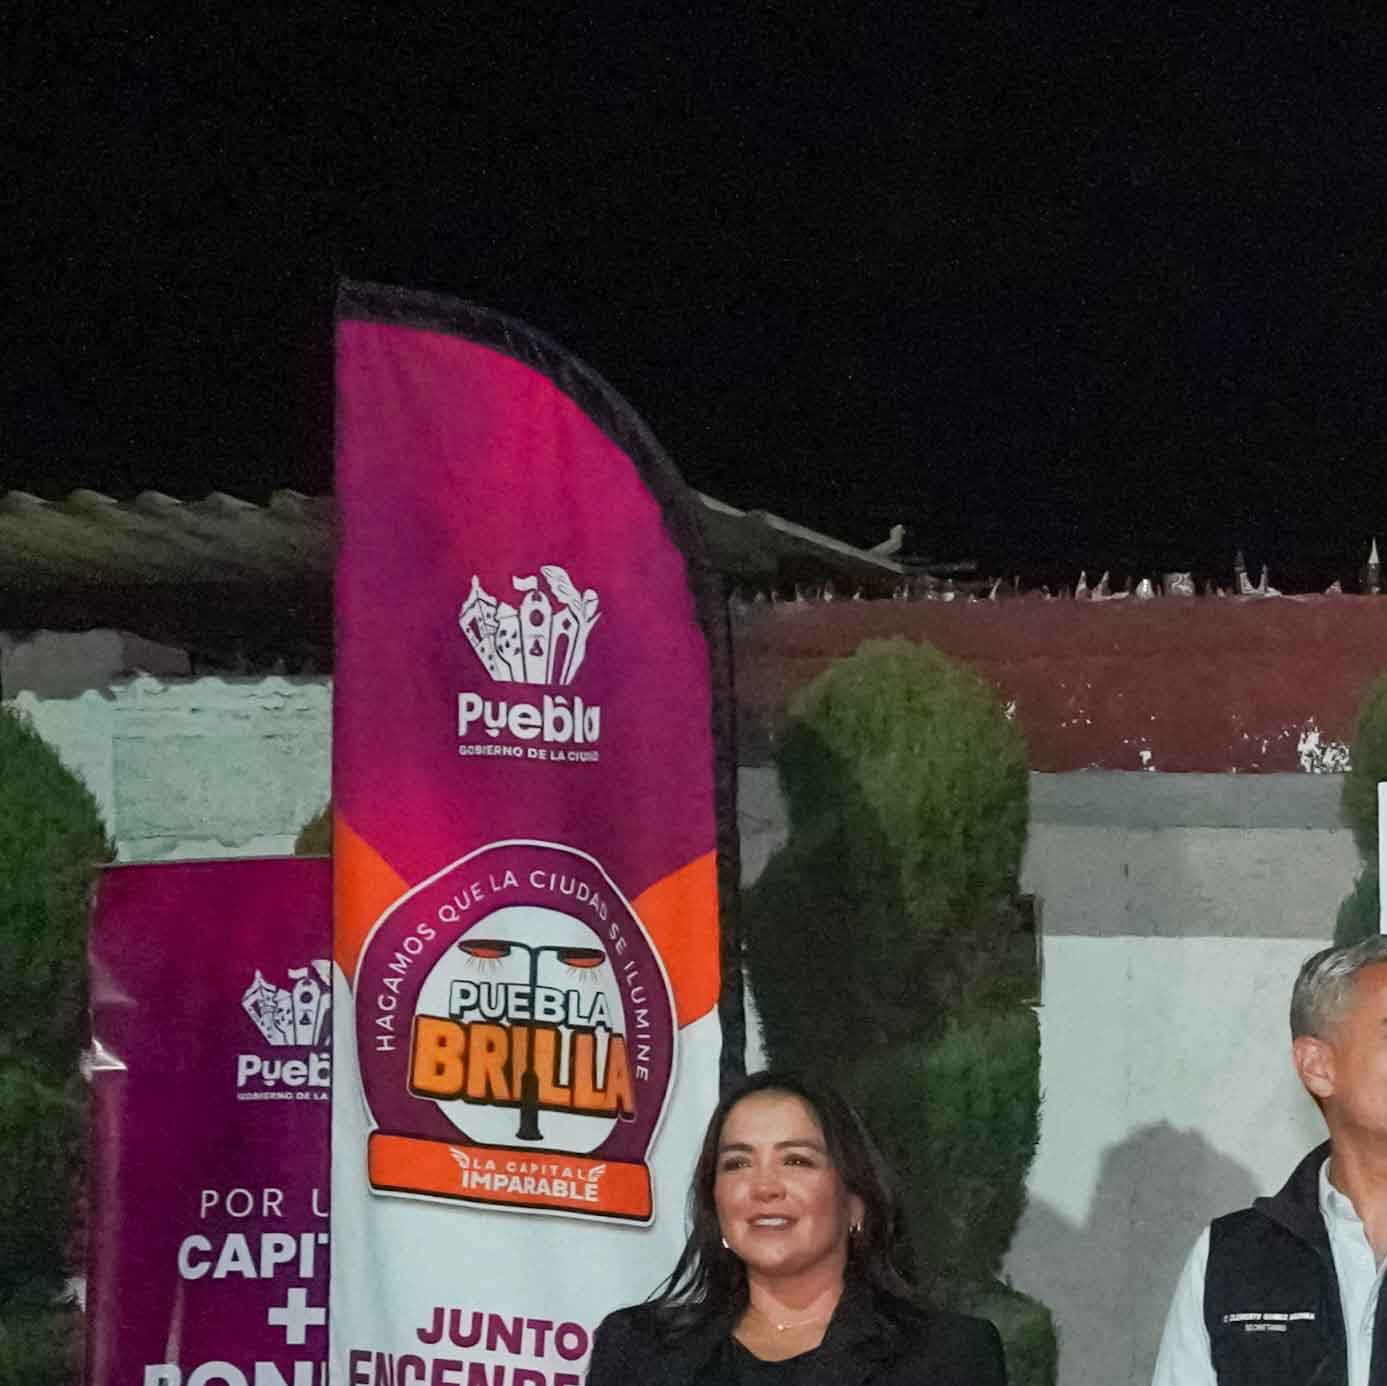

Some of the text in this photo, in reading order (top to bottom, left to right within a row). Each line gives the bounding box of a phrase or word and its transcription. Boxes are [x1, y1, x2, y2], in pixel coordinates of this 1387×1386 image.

[458, 692, 600, 743] Puebla
[458, 745, 523, 757] GOBIERNO
[527, 748, 547, 760] DE
[550, 751, 565, 761] LA
[376, 870, 651, 1081] HAGAMOS QUE LA CIUDAD SE ILUMINE
[450, 980, 613, 1033] PUEBLA
[411, 1015, 636, 1119] BRILLA
[461, 1170, 599, 1202] IMPARABLE
[472, 1157, 589, 1181] LA CAPITAL
[200, 1188, 284, 1219] POR
[416, 1307, 596, 1361] JUNTO
